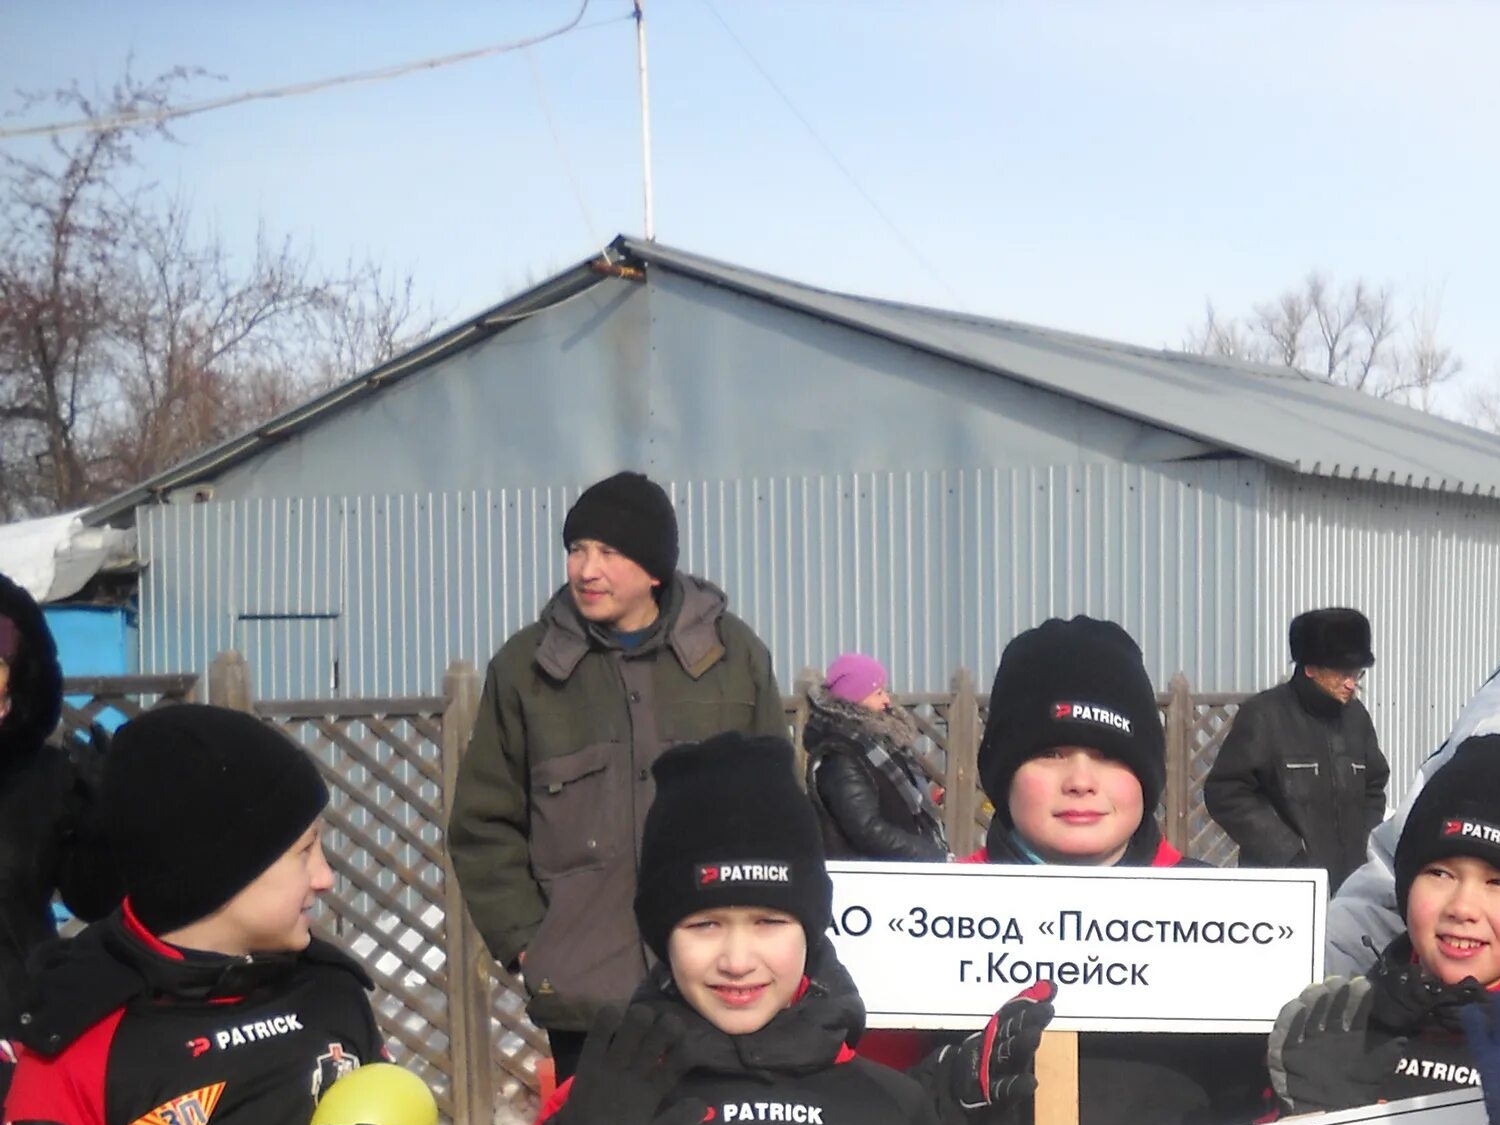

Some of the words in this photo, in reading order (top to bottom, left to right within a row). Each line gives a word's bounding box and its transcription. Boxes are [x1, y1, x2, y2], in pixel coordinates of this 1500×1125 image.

[1072, 704, 1131, 733] PATRICK
[720, 864, 789, 882] PATRICK
[888, 906, 1024, 945] «Завод
[1038, 910, 1295, 945] «Пластмасс»
[959, 952, 1150, 986] г.Копейск
[216, 1013, 304, 1051] PATRICK
[723, 1102, 823, 1125] PATRICK
